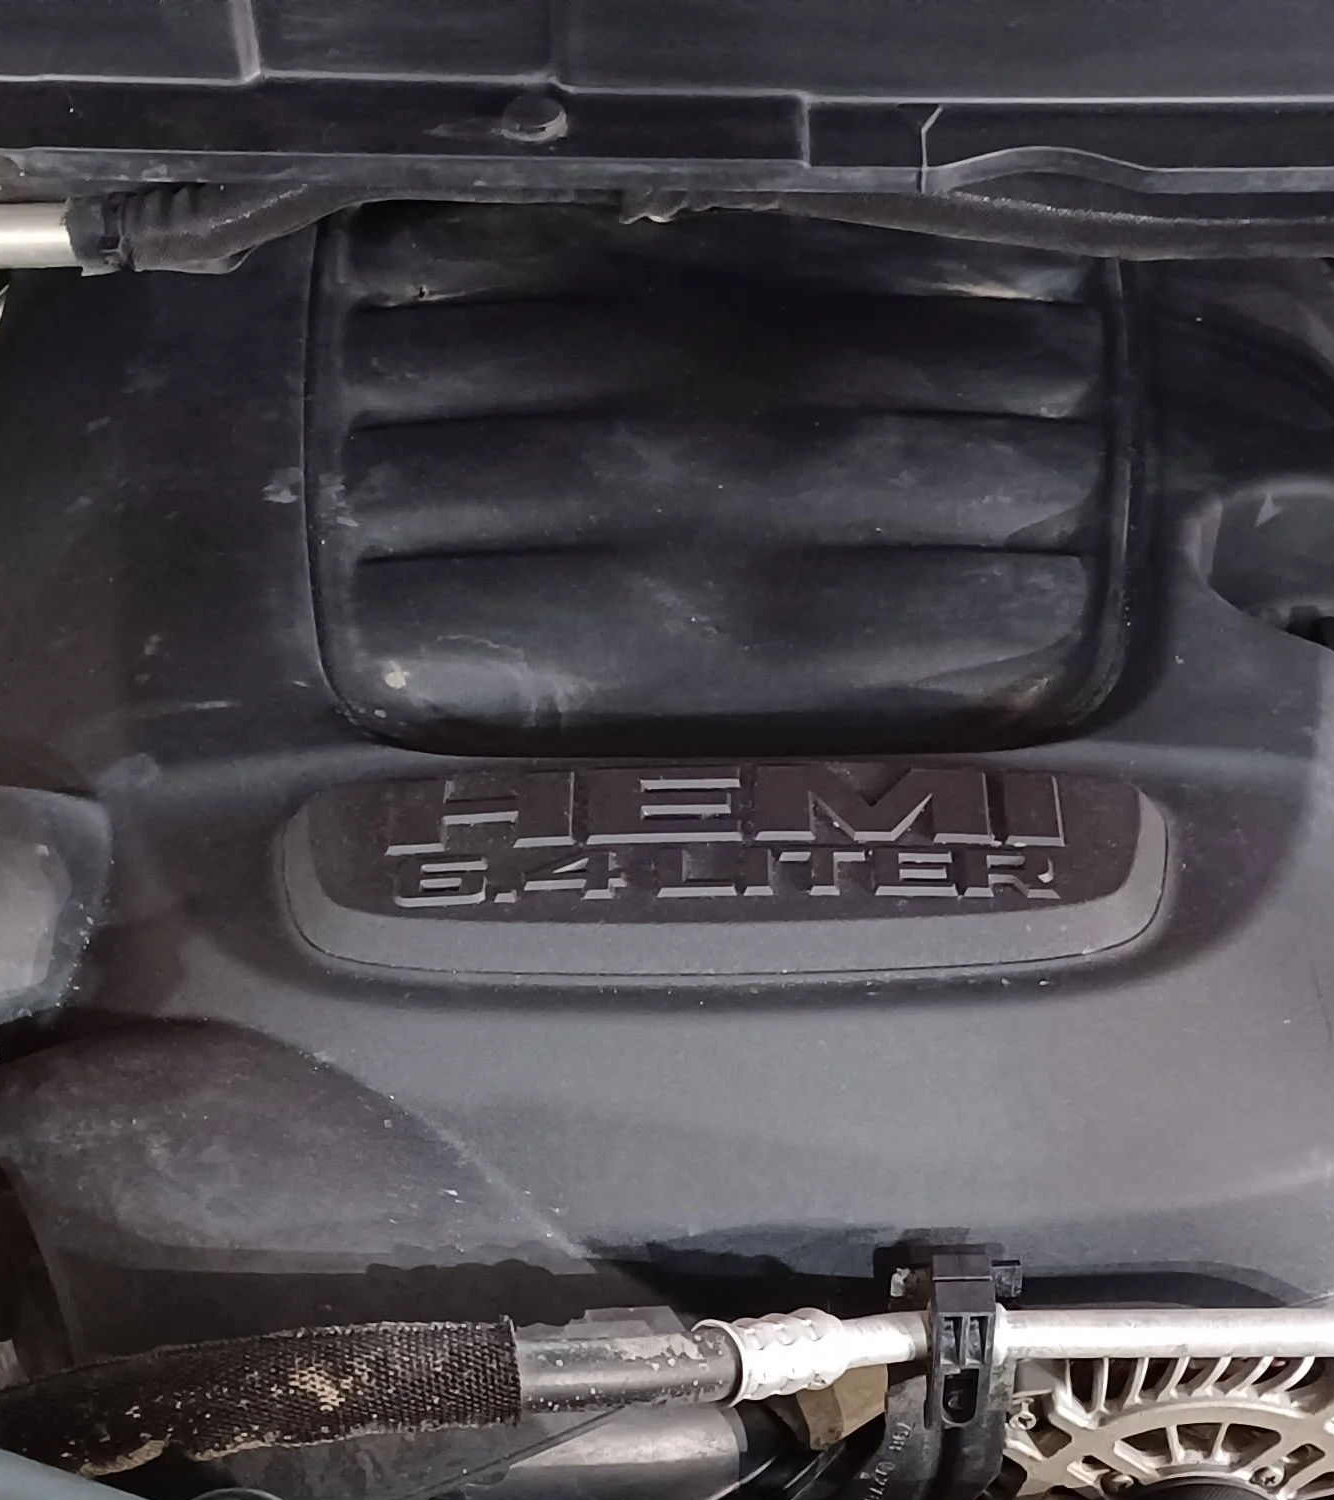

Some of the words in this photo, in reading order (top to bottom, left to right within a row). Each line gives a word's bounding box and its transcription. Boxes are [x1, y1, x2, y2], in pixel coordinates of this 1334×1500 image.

[387, 766, 1066, 857] HEMI
[393, 850, 629, 908] 6.4
[657, 846, 1060, 902] LITER
